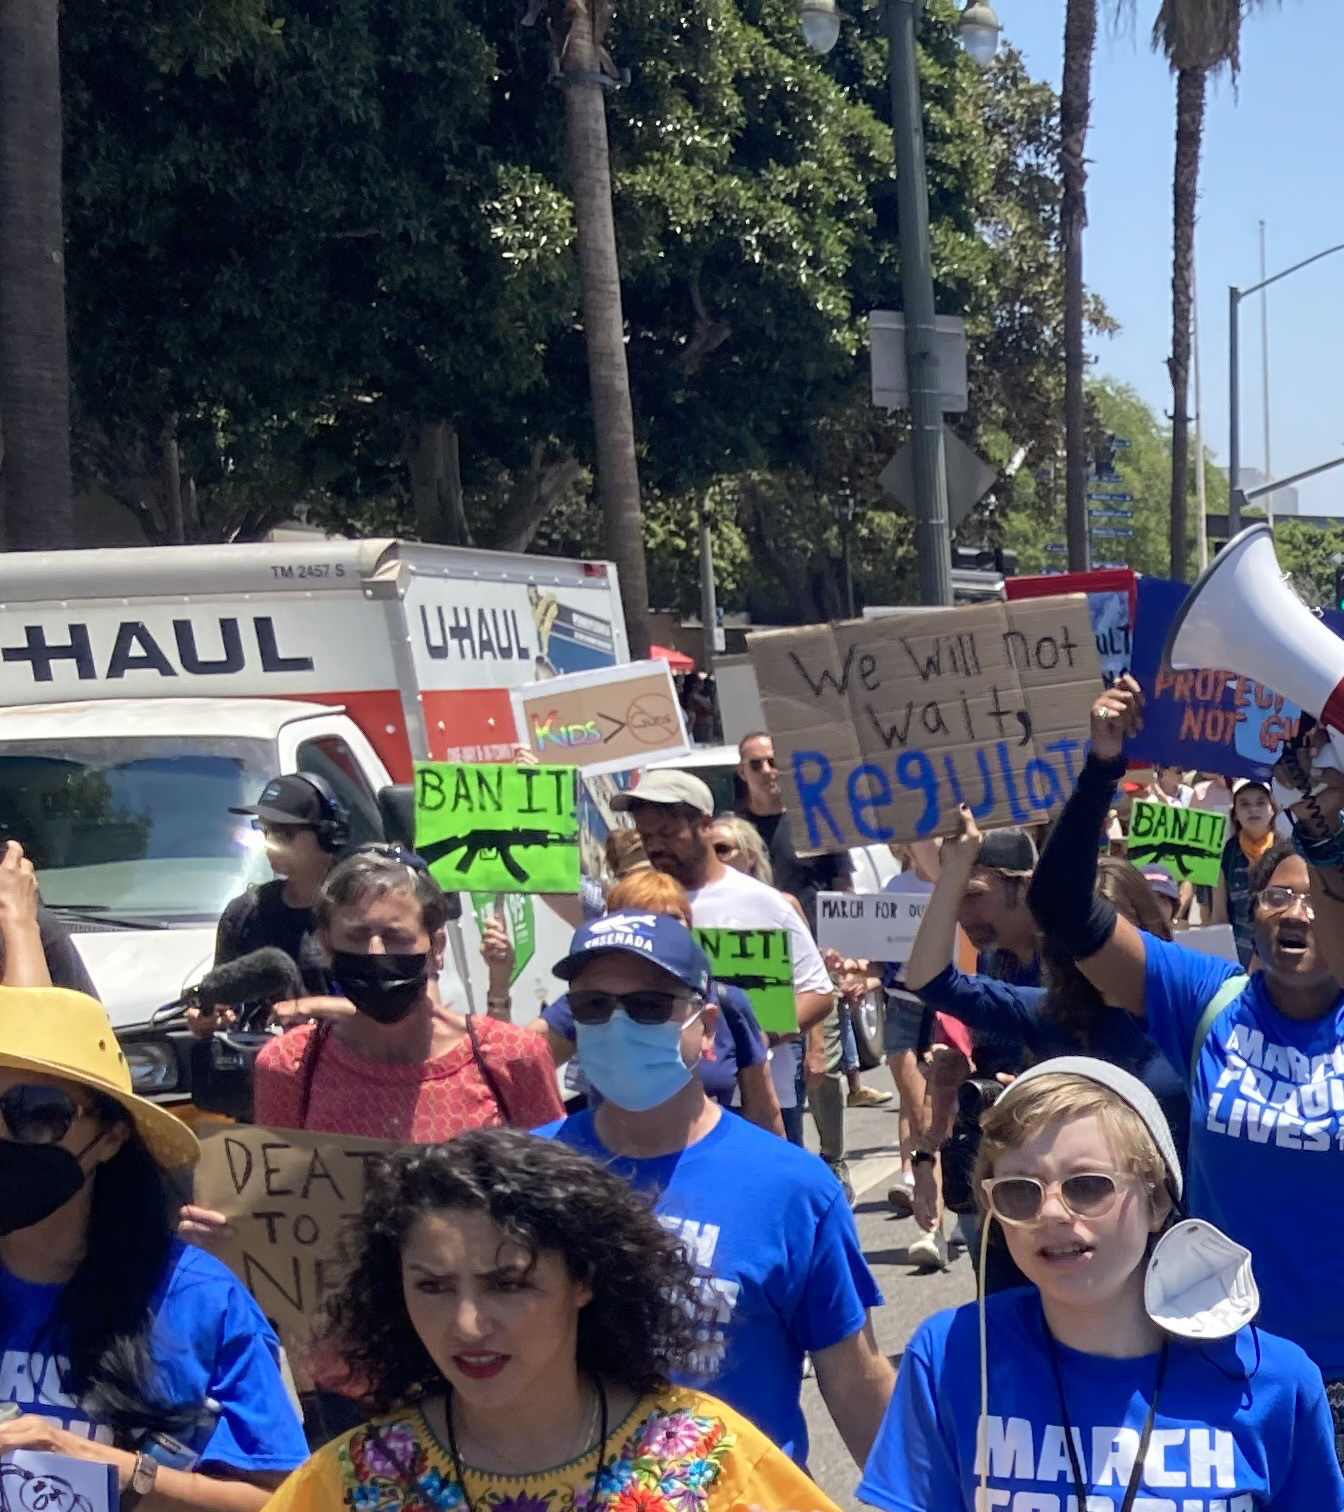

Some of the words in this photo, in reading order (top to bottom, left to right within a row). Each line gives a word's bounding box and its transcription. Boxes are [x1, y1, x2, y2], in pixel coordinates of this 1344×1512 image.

[271, 565, 294, 579] TM
[297, 564, 330, 578] 2457
[335, 564, 346, 577] S
[419, 605, 531, 660] U-HAUL
[788, 643, 882, 697] We
[1002, 626, 1079, 670] not
[1154, 665, 1287, 713] PROTEC
[1180, 706, 1246, 747] NOT
[418, 768, 503, 813] BAN
[1132, 802, 1190, 839] BAN
[1188, 811, 1227, 848] IT!
[822, 901, 864, 919] MARCH
[875, 902, 898, 919] FOR
[727, 930, 790, 963] IT!
[1216, 1054, 1300, 1117] FOR
[1207, 1093, 1331, 1151] LIVES
[224, 1138, 385, 1200] DEAT
[252, 1212, 319, 1245] TO
[974, 1415, 1236, 1488] MARCH
